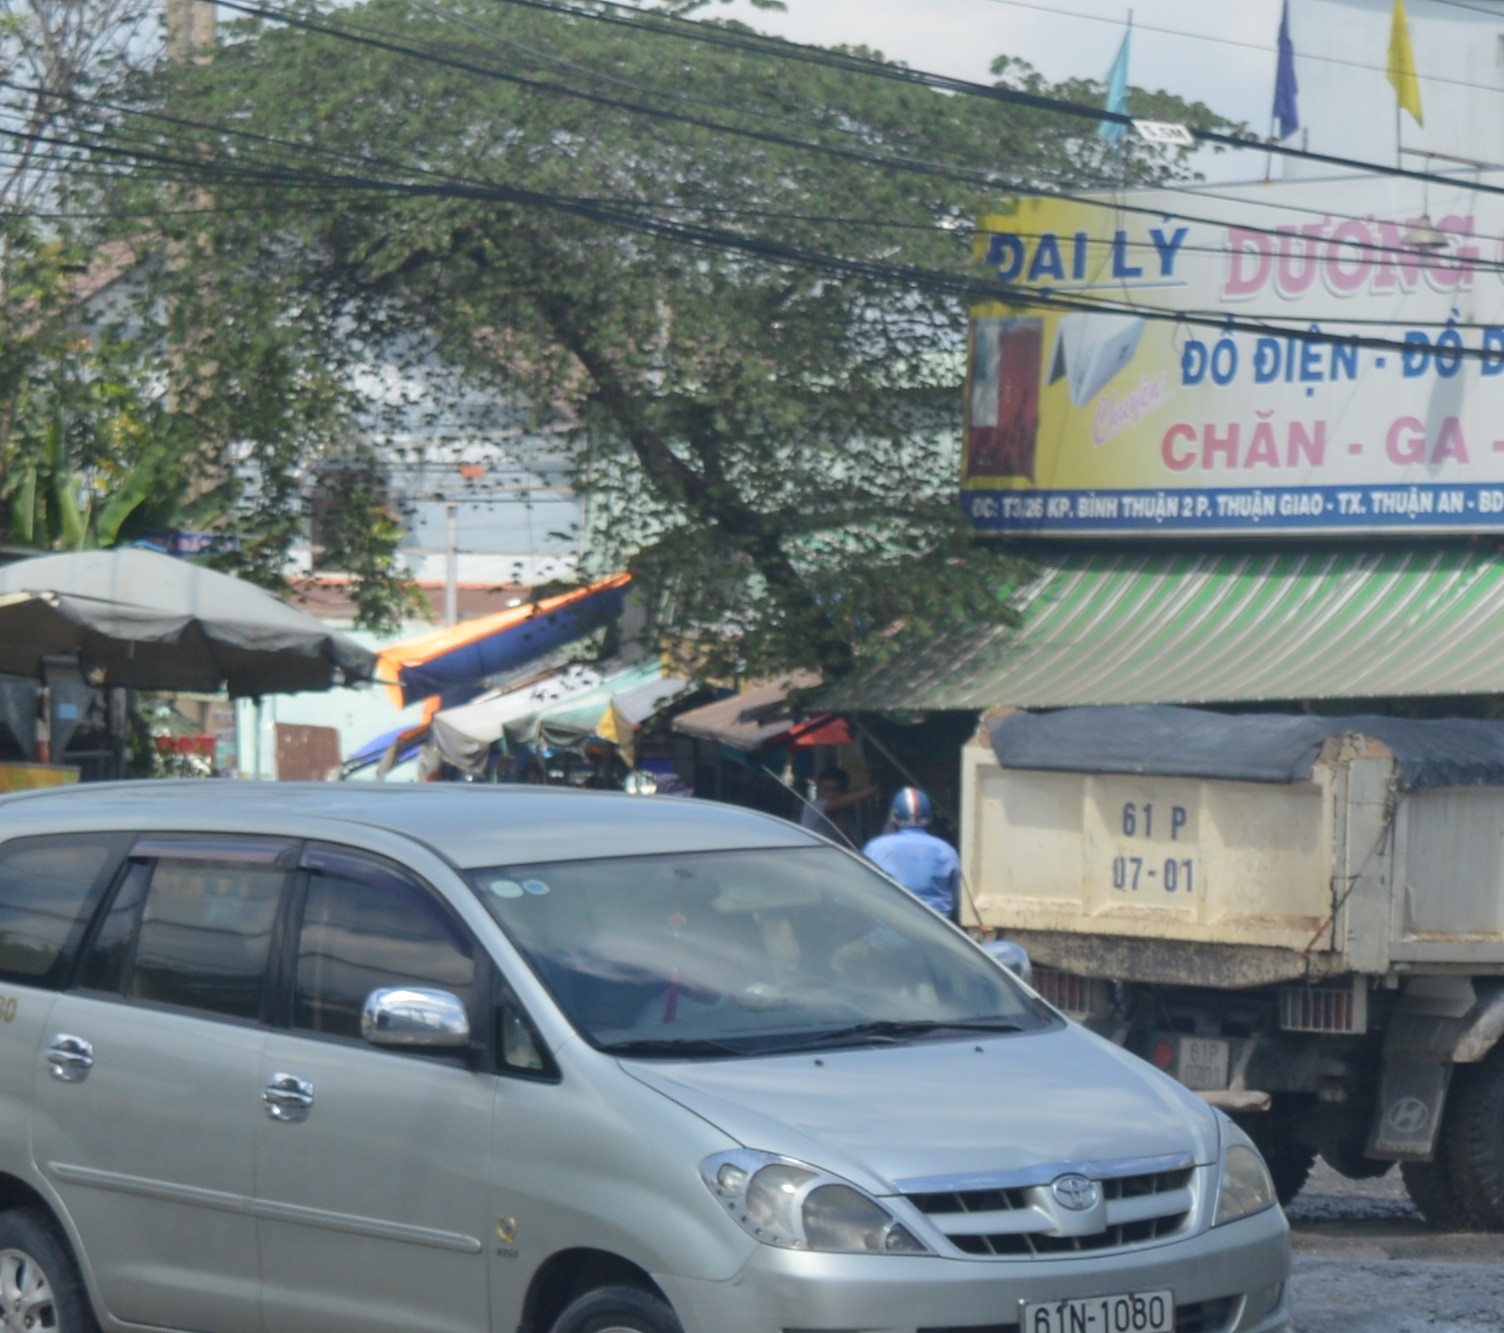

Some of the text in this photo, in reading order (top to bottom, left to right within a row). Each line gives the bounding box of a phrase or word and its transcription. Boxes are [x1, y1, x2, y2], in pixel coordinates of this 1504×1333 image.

[986, 213, 1190, 300] ĐẠI LÝ
[1222, 211, 1480, 297] DƯƠNG
[1253, 322, 1358, 398] ĐIỆN
[1402, 306, 1463, 379] ĐỒ
[1161, 409, 1328, 472] CHĂN
[1385, 415, 1470, 466] GA
[1120, 491, 1180, 523] THUẬN
[1181, 496, 1194, 517] 2
[1216, 489, 1276, 522] THUẬN
[1278, 493, 1324, 516] GIAO
[1336, 492, 1367, 515] TX.
[1371, 486, 1434, 519] THUẬN
[1437, 490, 1465, 514] AN
[1121, 802, 1188, 840] 61 P
[1113, 856, 1195, 893] 07-01
